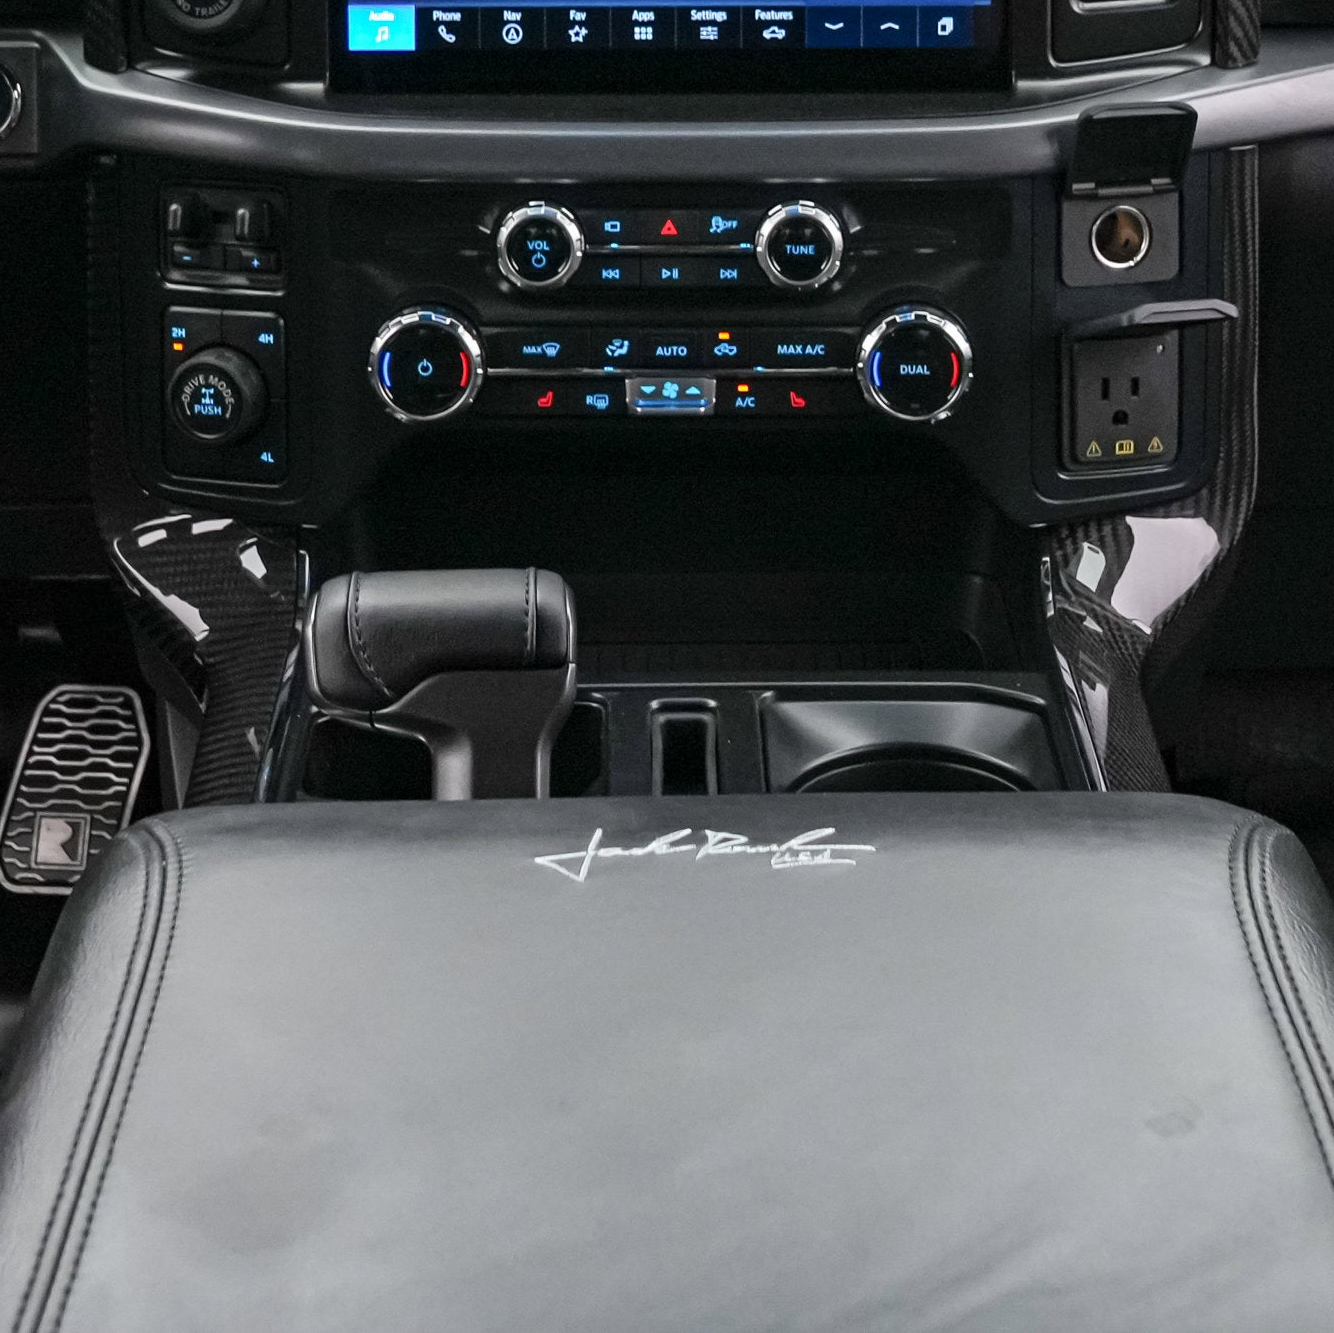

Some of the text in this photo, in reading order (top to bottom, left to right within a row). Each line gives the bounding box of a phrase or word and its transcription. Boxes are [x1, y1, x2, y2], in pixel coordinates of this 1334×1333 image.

[432, 9, 462, 22] Phone
[503, 9, 523, 22] Nav
[569, 9, 587, 22] Fav
[631, 9, 655, 24] Apps
[690, 9, 728, 24] Settings
[754, 9, 794, 21] Features
[527, 240, 550, 251] VOL
[785, 244, 815, 255] TUNE
[171, 326, 186, 338] 2H
[258, 333, 274, 345] 4H
[522, 345, 543, 354] MAX
[655, 345, 688, 357] AUTO
[777, 344, 825, 356] MAX A/C
[899, 364, 930, 375] DUAL
[181, 374, 235, 405] DRIVE MODE
[735, 396, 756, 409] A/C
[194, 404, 222, 416] PUSH
[260, 451, 275, 464] 4L
